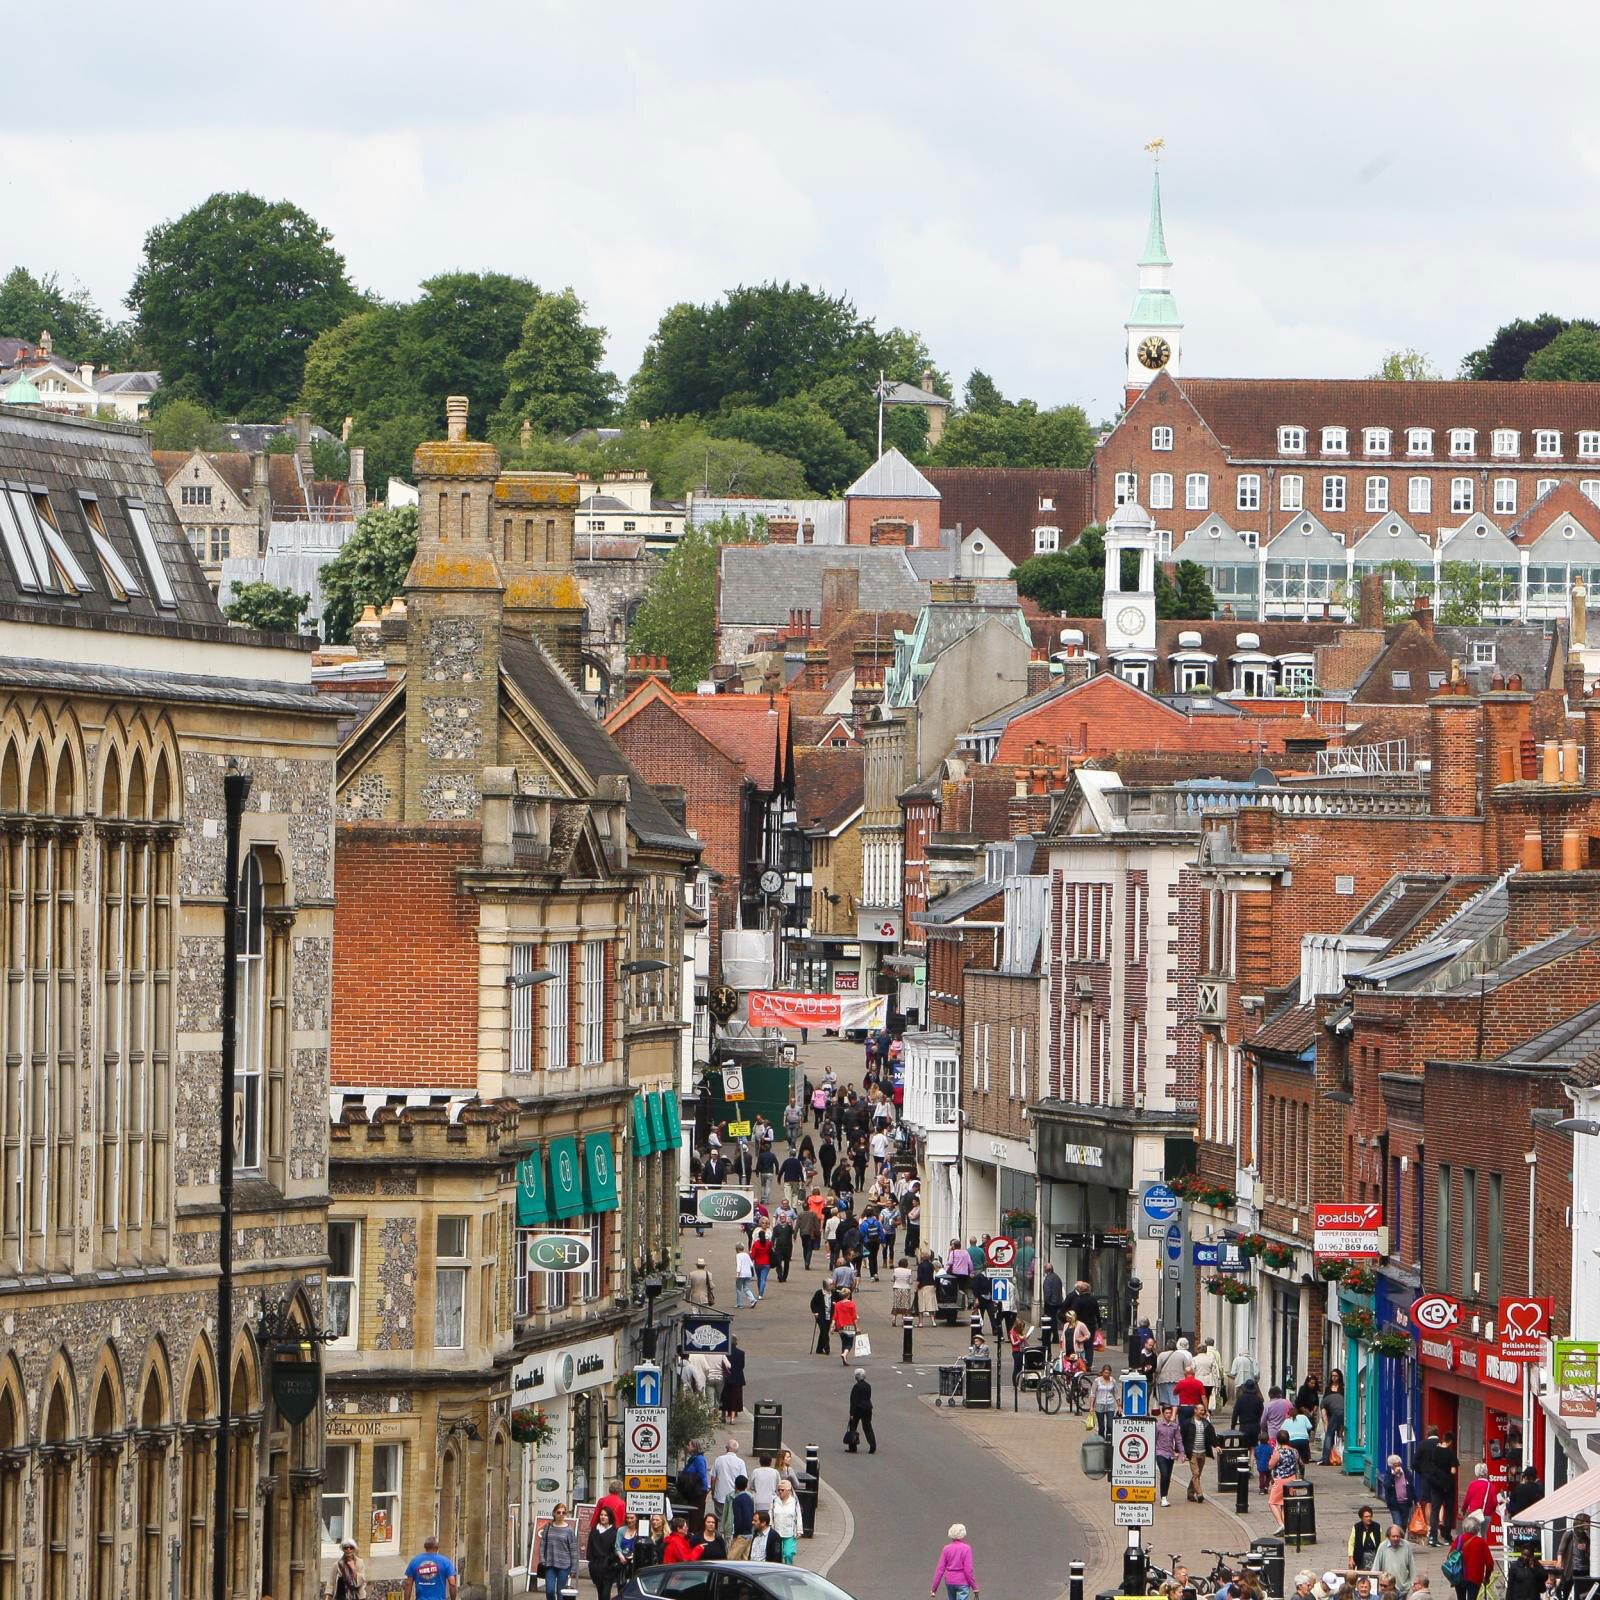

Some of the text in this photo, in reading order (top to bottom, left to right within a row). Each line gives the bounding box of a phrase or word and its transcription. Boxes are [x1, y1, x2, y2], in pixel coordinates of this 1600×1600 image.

[835, 980, 858, 989] SALE
[752, 994, 838, 1013] CASCADES
[710, 1195, 739, 1207] Coffee
[714, 1207, 738, 1219] Shop
[1317, 1211, 1367, 1228] goadsby
[1318, 1243, 1343, 1251] 01962
[1345, 1243, 1361, 1251] 869
[537, 1243, 581, 1264] C&H
